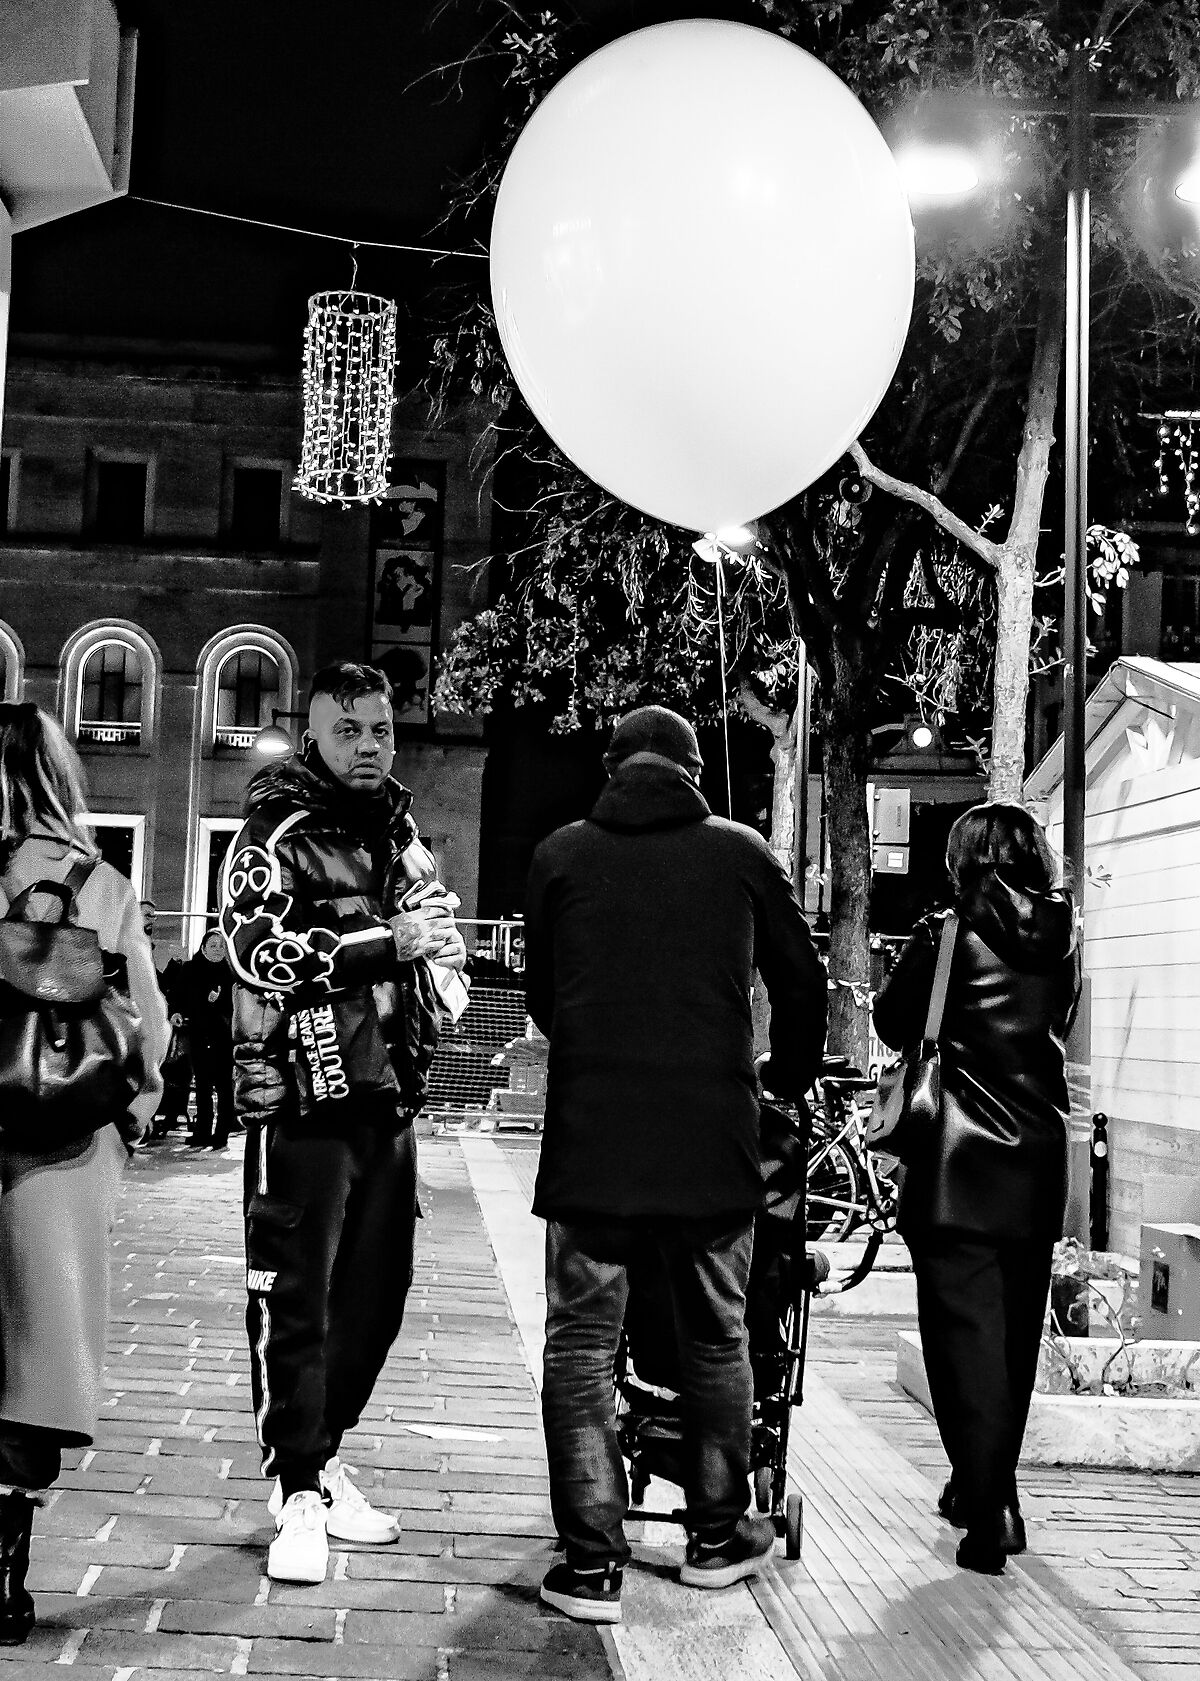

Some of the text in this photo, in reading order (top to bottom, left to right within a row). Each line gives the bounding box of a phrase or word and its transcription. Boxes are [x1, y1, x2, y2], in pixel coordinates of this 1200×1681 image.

[297, 1009, 328, 1102] VERSACE JEANS
[310, 1004, 350, 1099] COUTURE
[247, 1269, 278, 1292] NIKE
